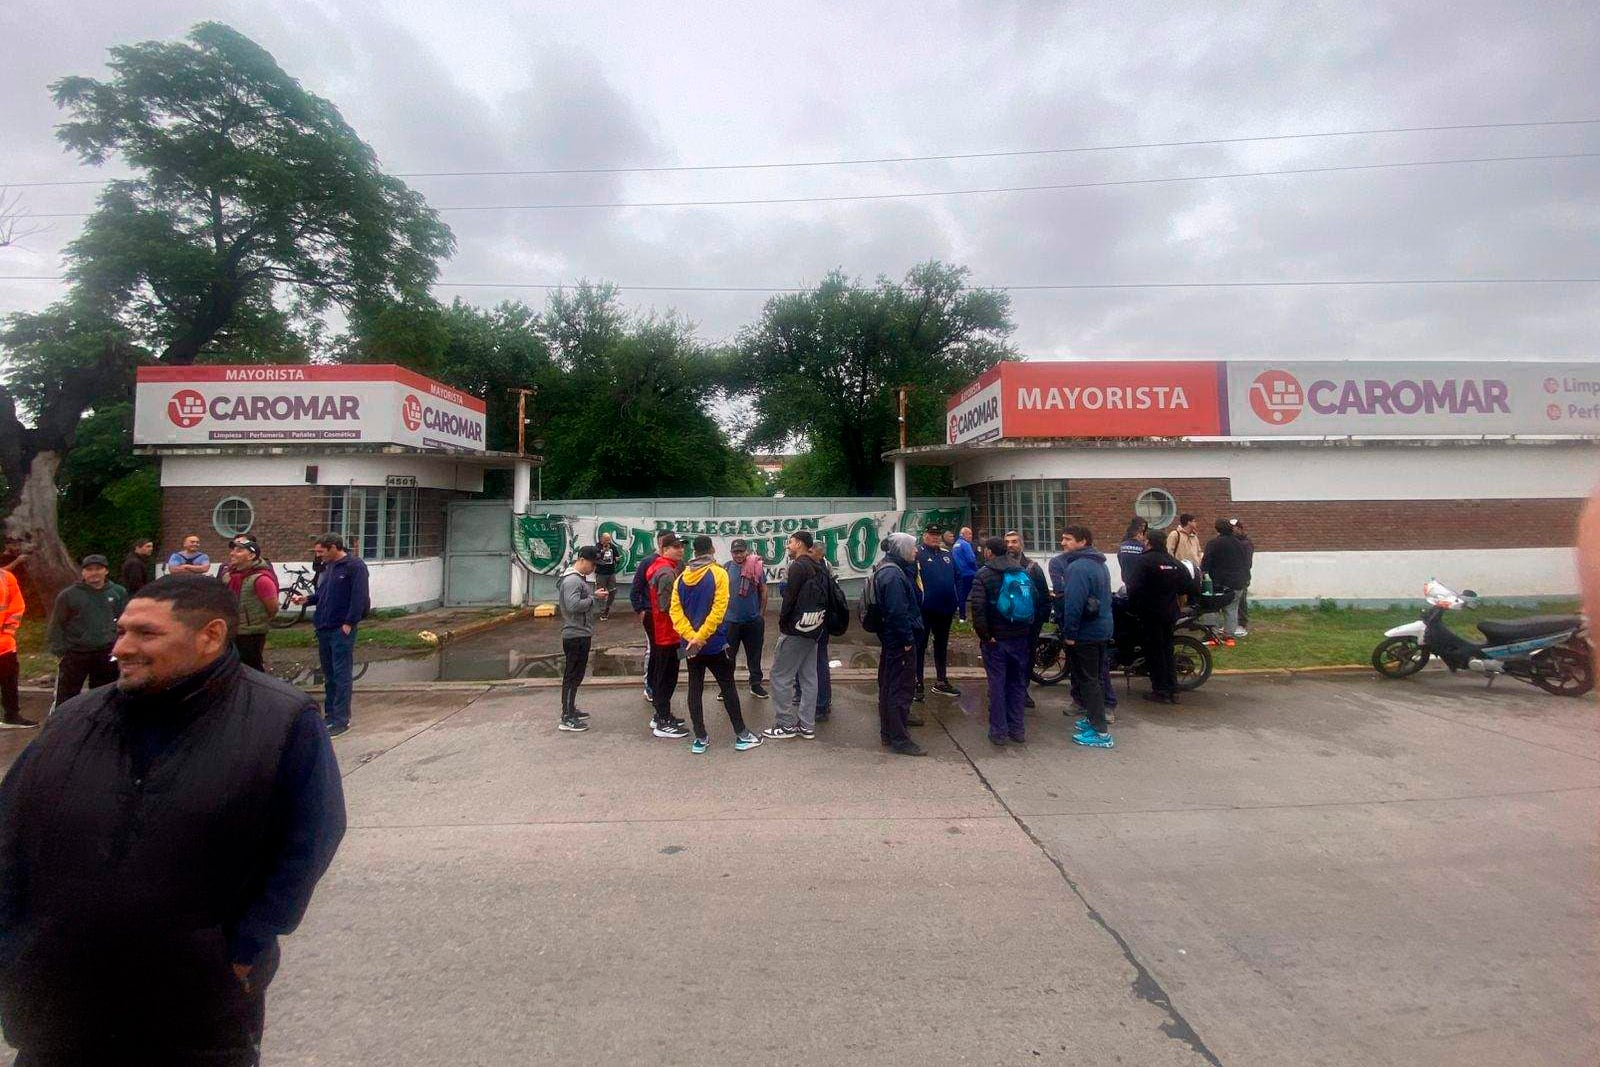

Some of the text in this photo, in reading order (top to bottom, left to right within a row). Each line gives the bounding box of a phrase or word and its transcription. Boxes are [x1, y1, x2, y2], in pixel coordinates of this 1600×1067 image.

[225, 368, 305, 381] MAYORISTA
[430, 383, 464, 405] MAYORISTA
[1016, 386, 1189, 410] MAYORISTA
[1307, 379, 1512, 415] CAROMAR
[208, 395, 361, 422] CAROMAR
[957, 396, 998, 435] CAROMAR
[213, 431, 242, 440] Limpieza
[422, 406, 483, 442] CAROMAR
[655, 517, 819, 534] DELEGACION
[743, 517, 880, 570] UTO
[800, 609, 826, 625] NIKE
